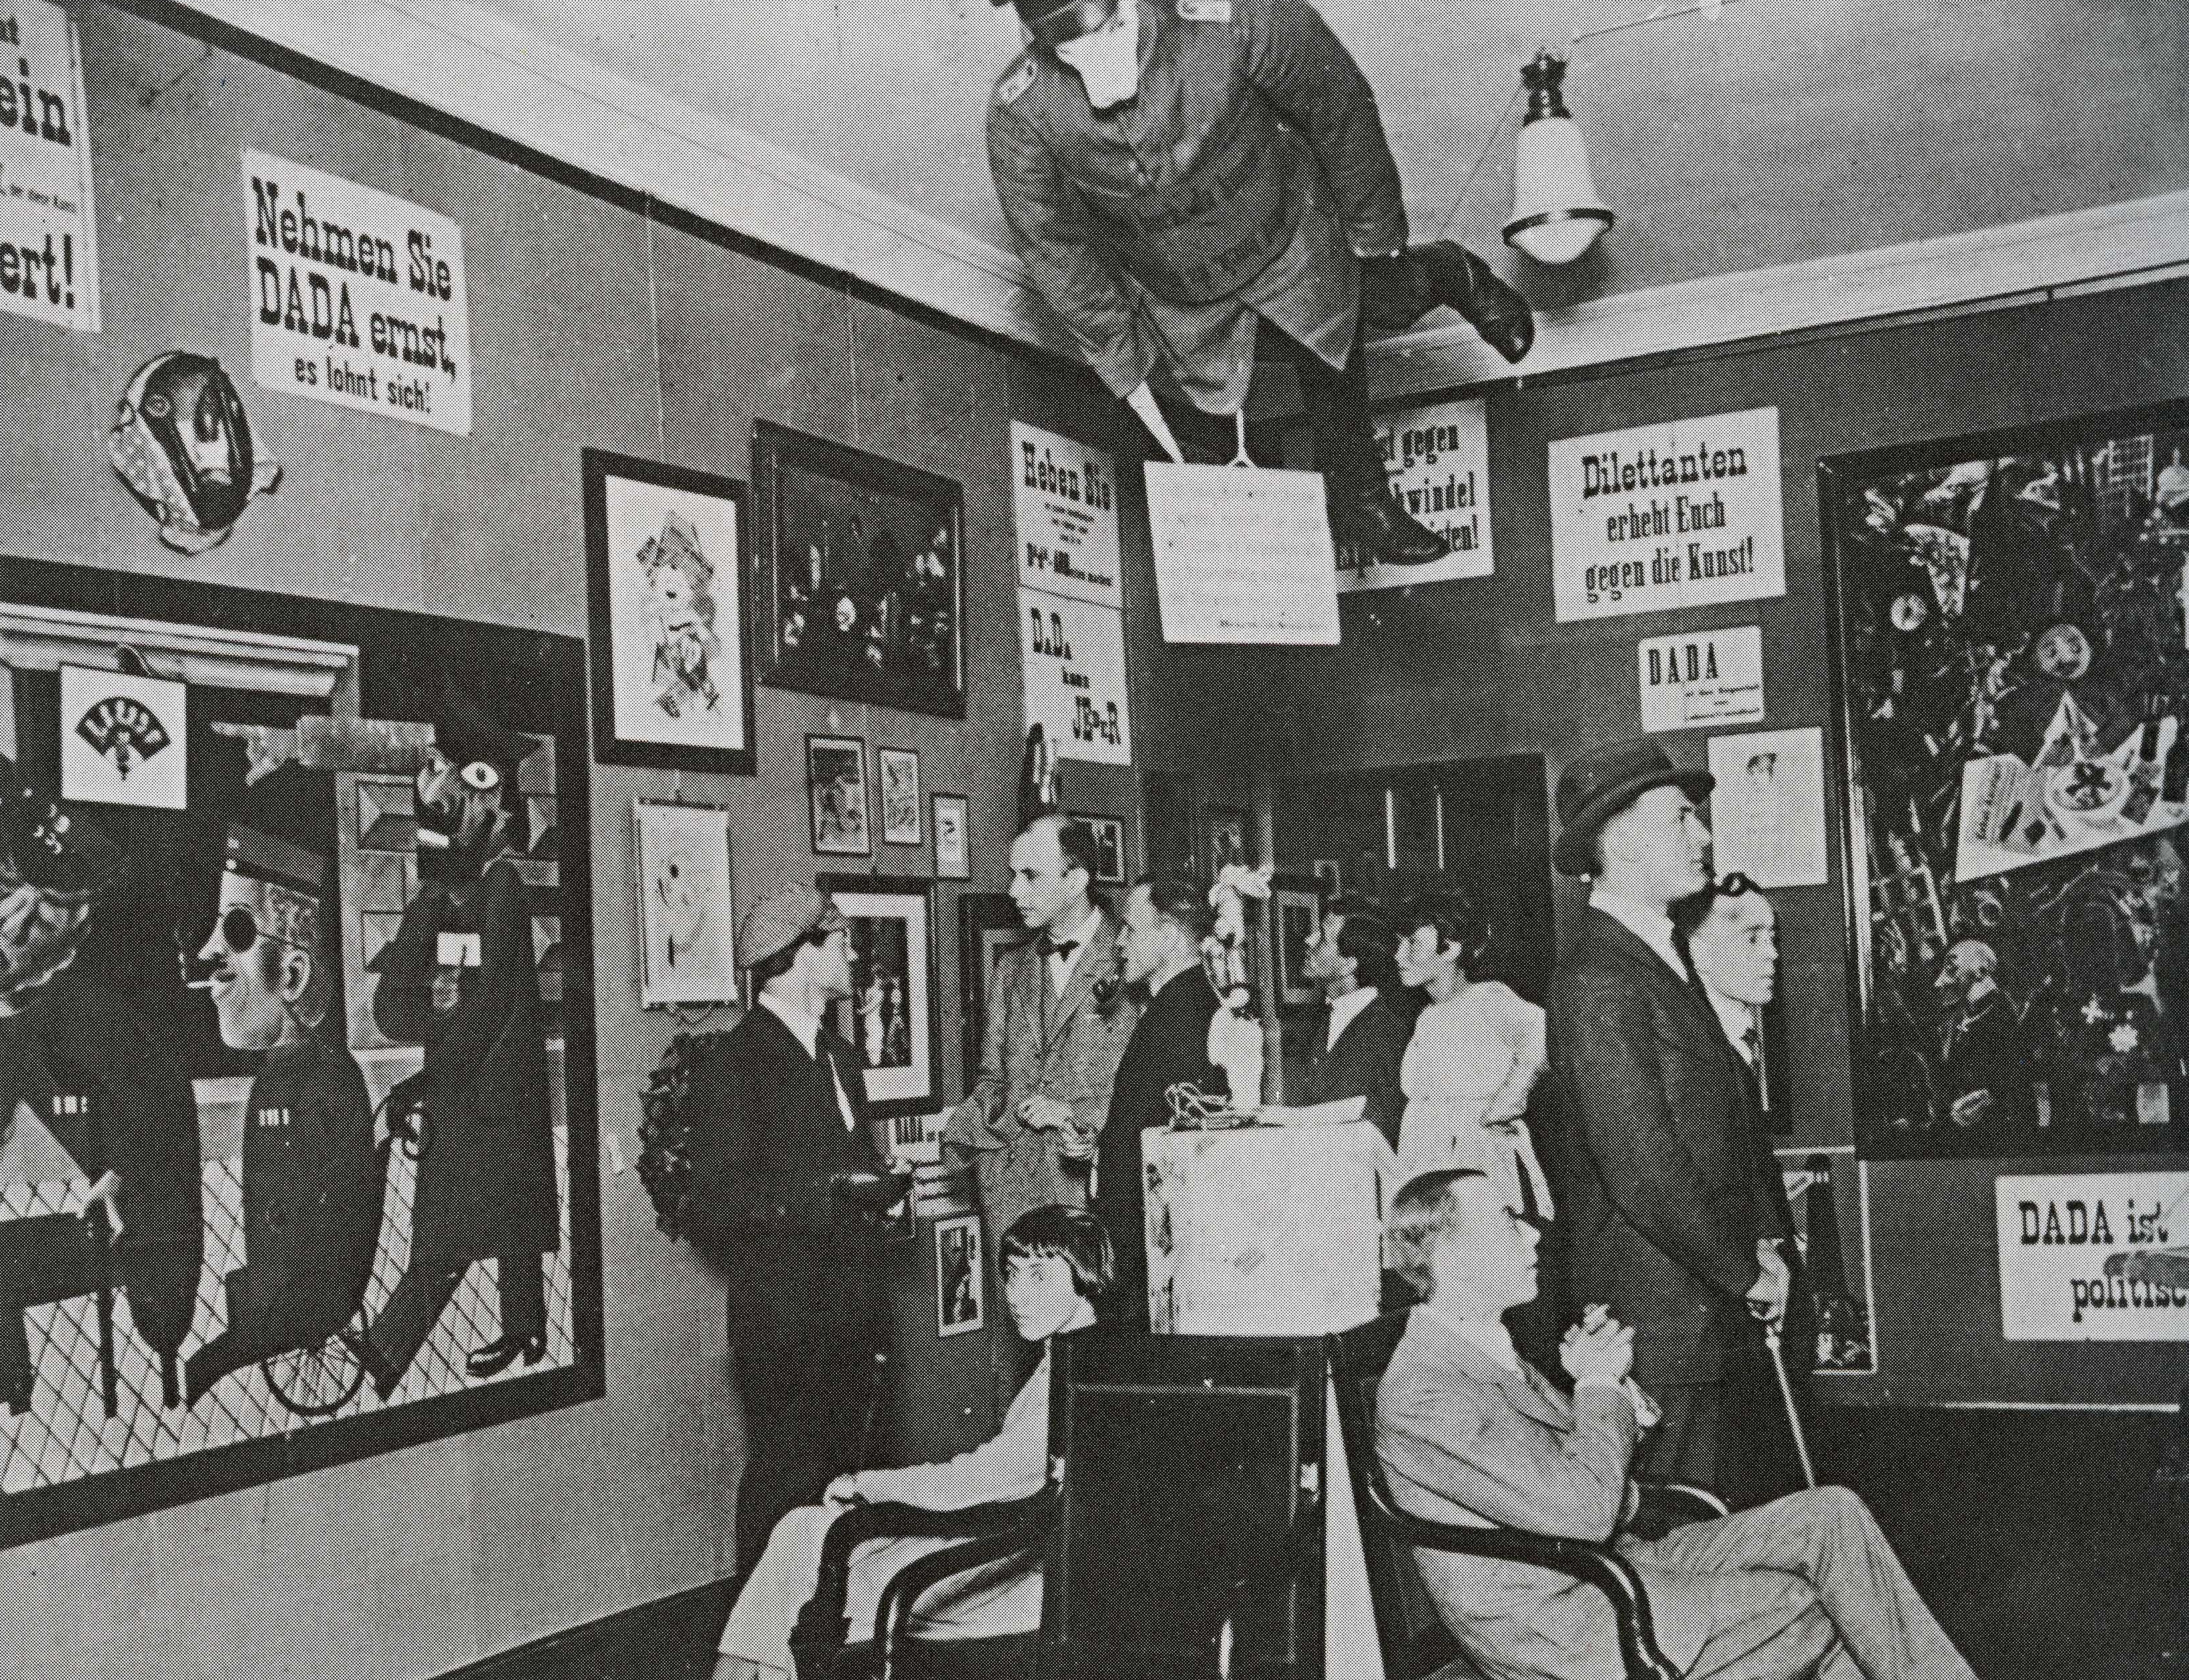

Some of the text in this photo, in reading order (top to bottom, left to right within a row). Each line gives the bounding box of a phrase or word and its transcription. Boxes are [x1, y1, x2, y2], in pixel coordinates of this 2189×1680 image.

[252, 176, 452, 302] Nehmen Sie
[256, 255, 457, 385] DADA ernst,
[295, 354, 432, 414] es lohnt sich!
[1022, 439, 1110, 511] Heben Sie
[1402, 425, 1460, 468] gegen
[1581, 441, 1748, 500] Dilettanten
[1606, 490, 1726, 542] erhebt Euch
[1584, 535, 1755, 604] gegen die Kunst!
[1030, 607, 1073, 661] DADA
[1647, 641, 1719, 686] DADA
[2018, 1197, 2169, 1245] DADA ist
